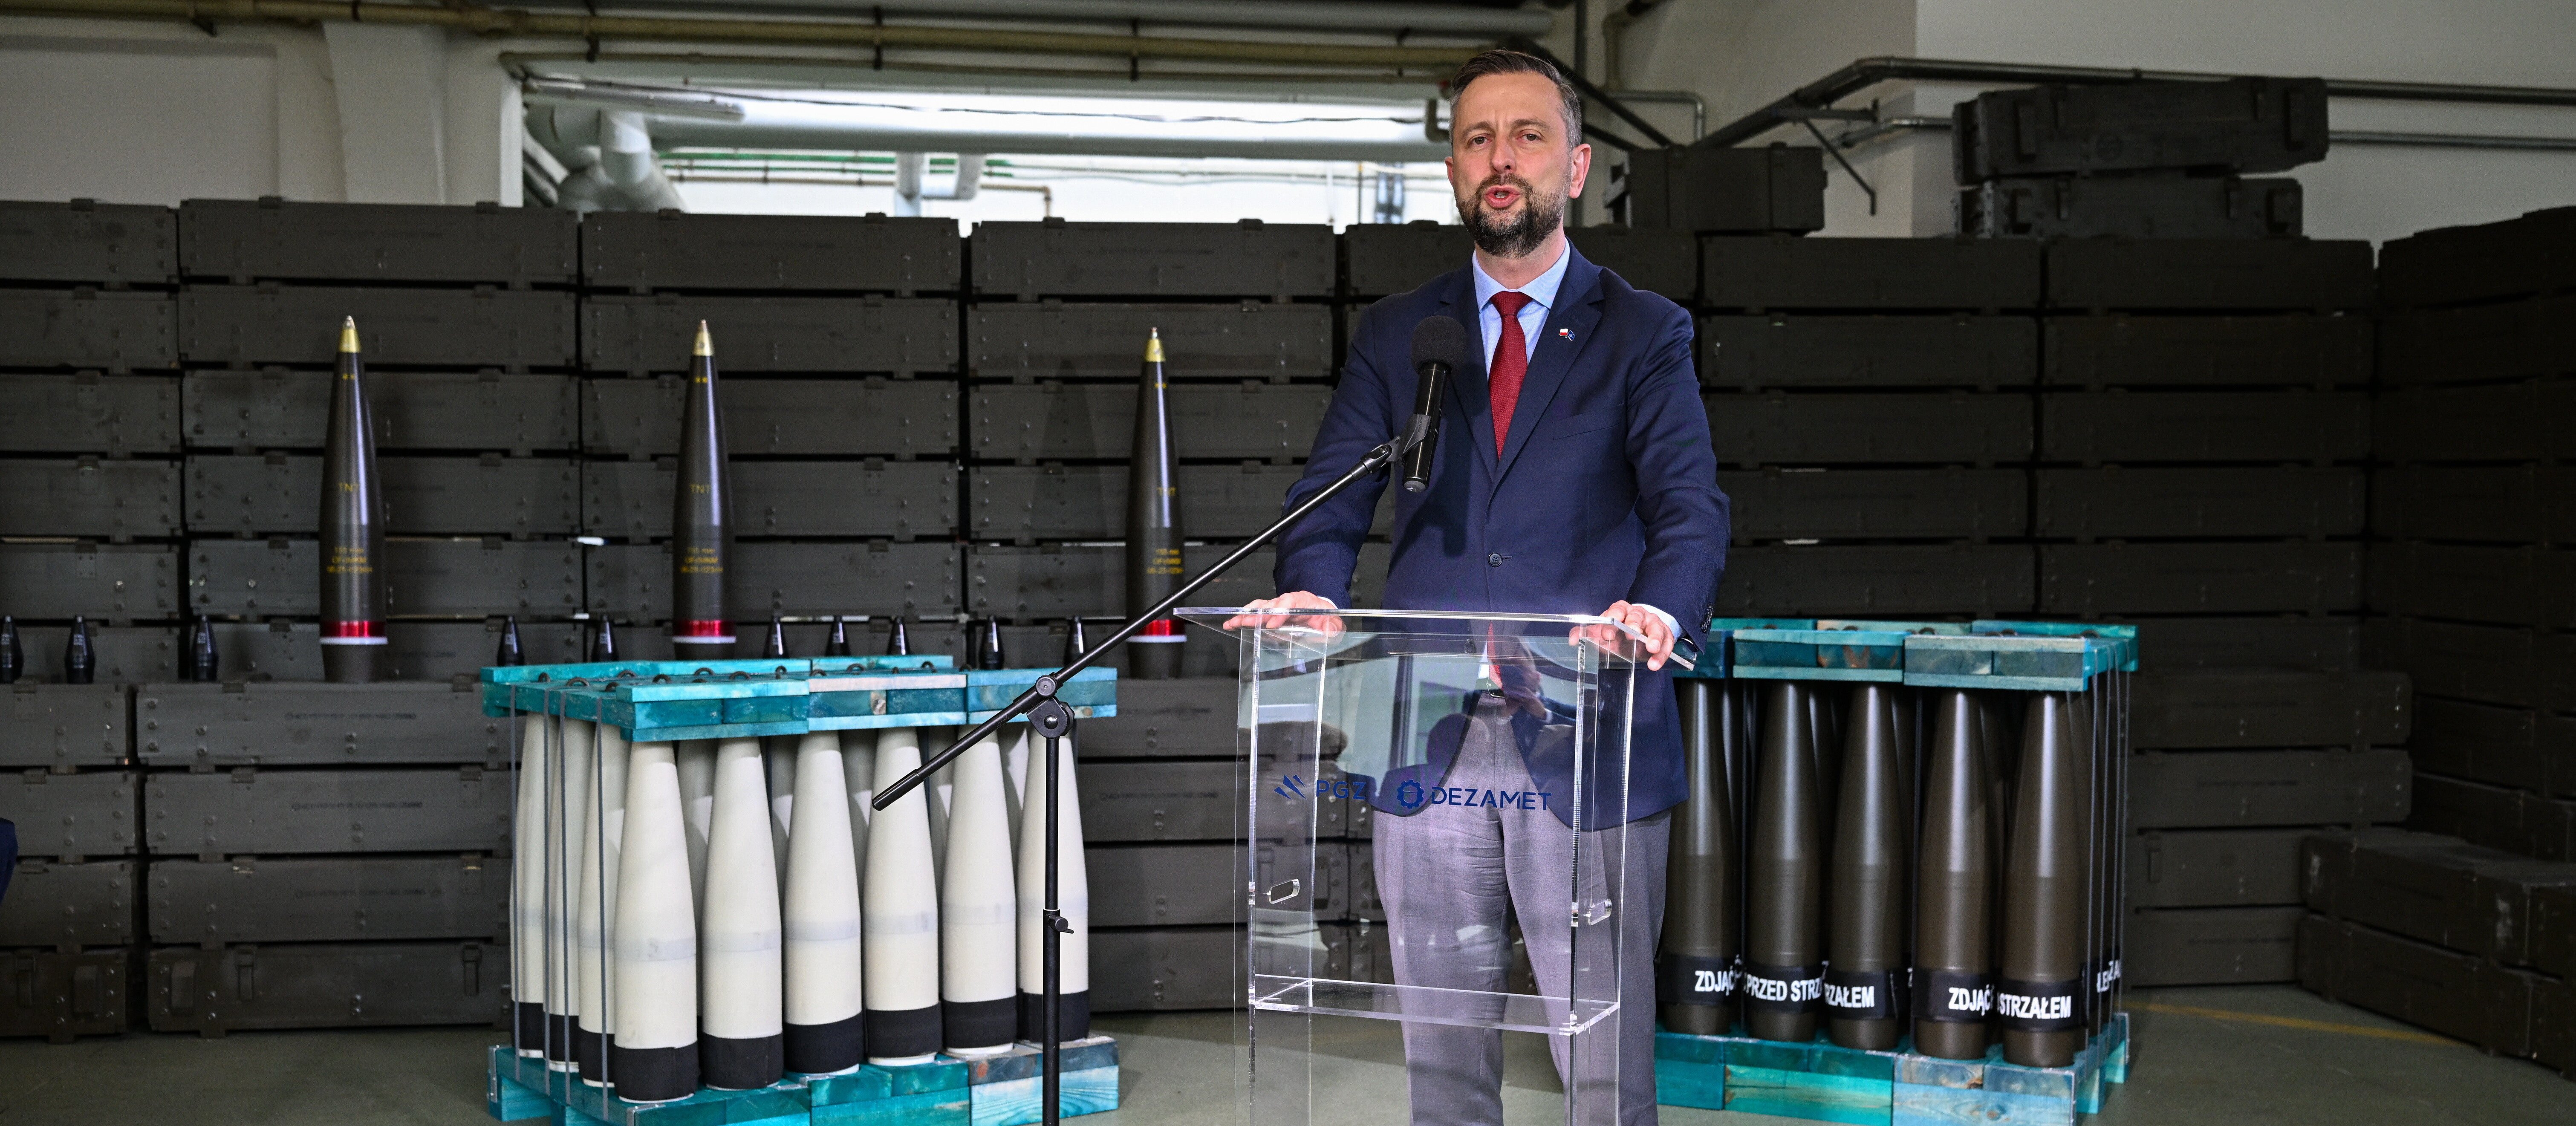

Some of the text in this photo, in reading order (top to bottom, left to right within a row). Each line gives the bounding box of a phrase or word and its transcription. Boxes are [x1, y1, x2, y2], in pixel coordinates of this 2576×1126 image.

[1316, 780, 1366, 800] PGZ
[1432, 786, 1552, 811] DEZAMET
[1746, 974, 1788, 1002] PRZED
[1948, 984, 1991, 1016] ZDJĄĆ
[1999, 992, 2071, 1019] STRZAŁEM
